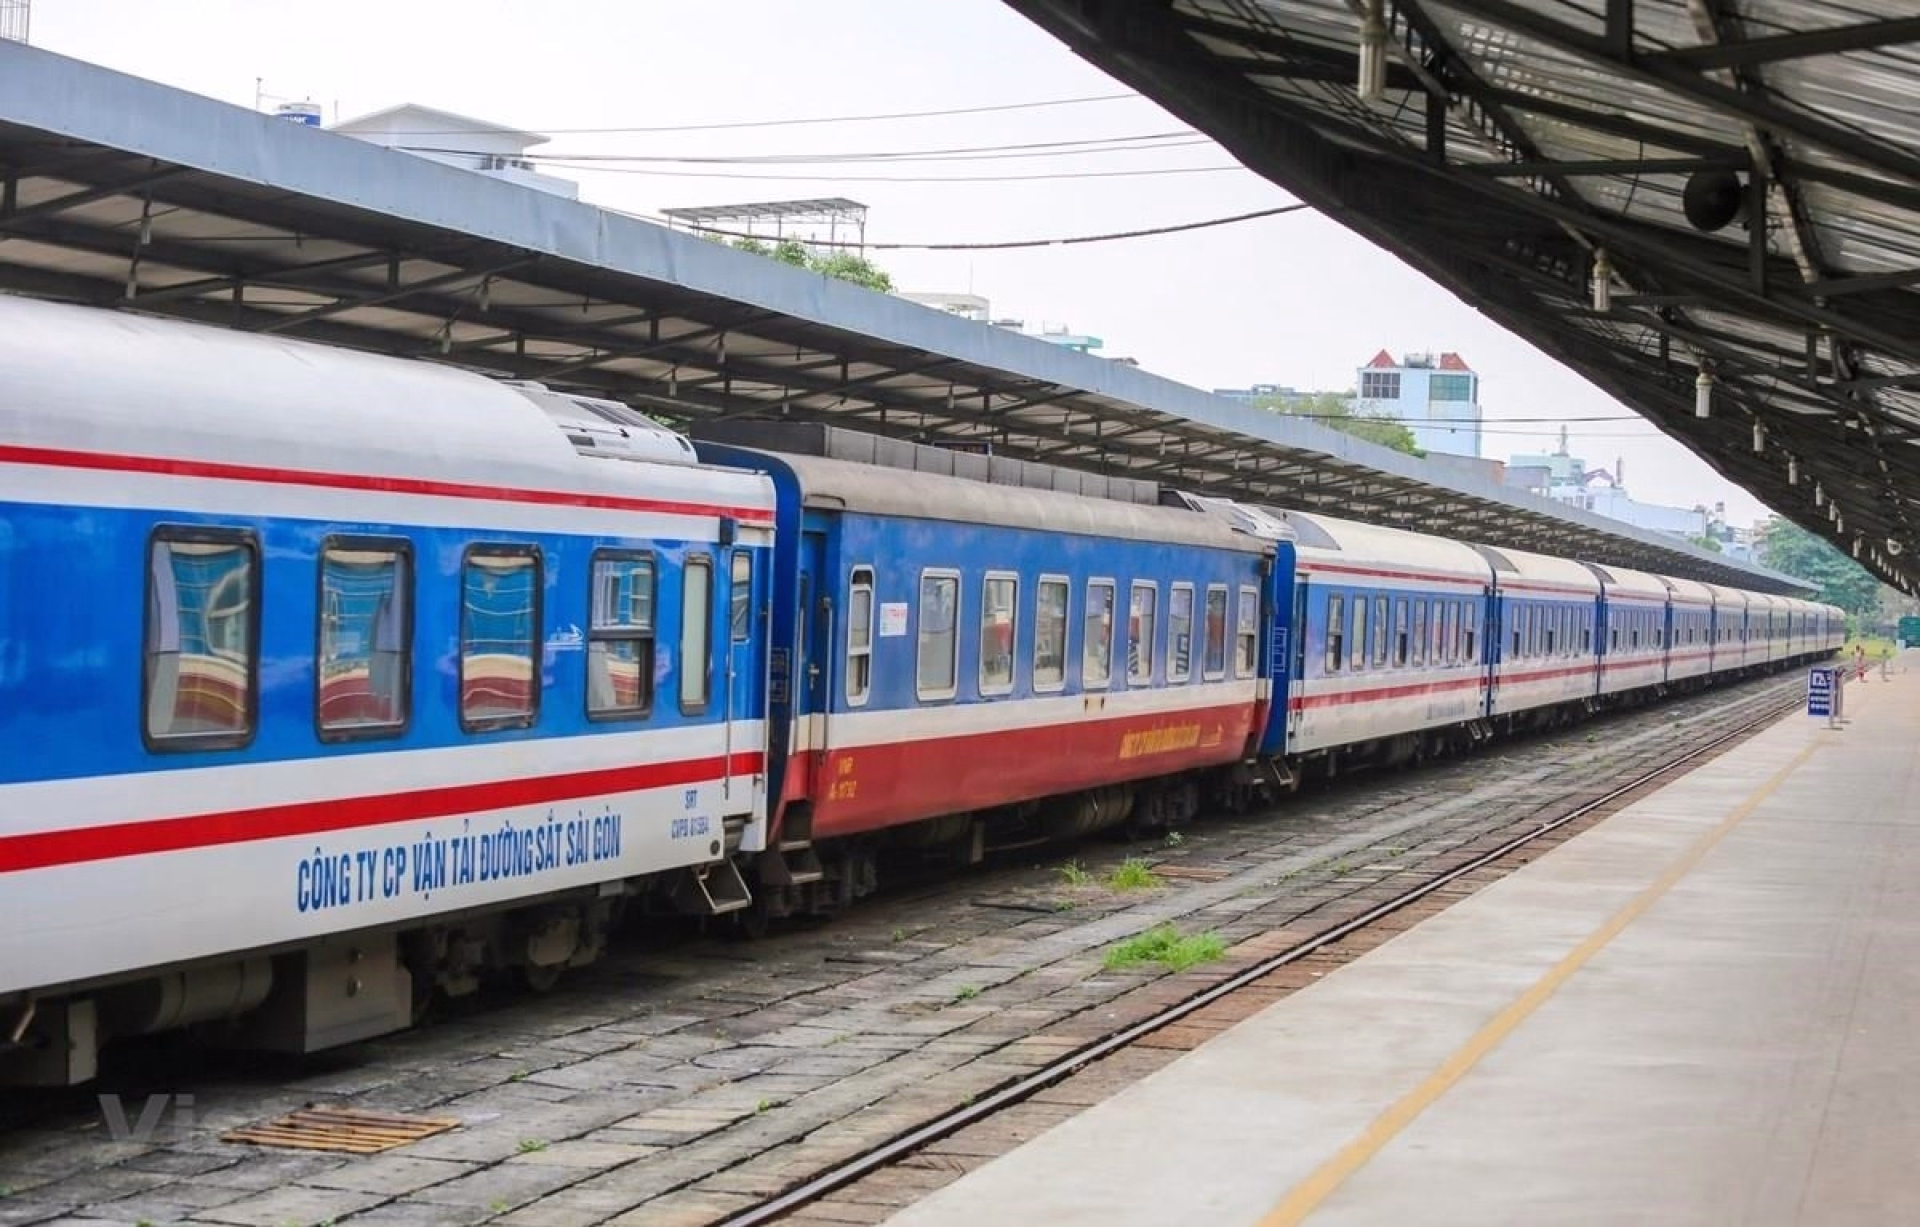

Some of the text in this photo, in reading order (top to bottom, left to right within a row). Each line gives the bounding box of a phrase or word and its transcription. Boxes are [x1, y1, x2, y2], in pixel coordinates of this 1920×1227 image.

[298, 805, 621, 912] CÔNG TY CP VẬN TẢI ĐƯỜNG SẮT SÀI GÒN
